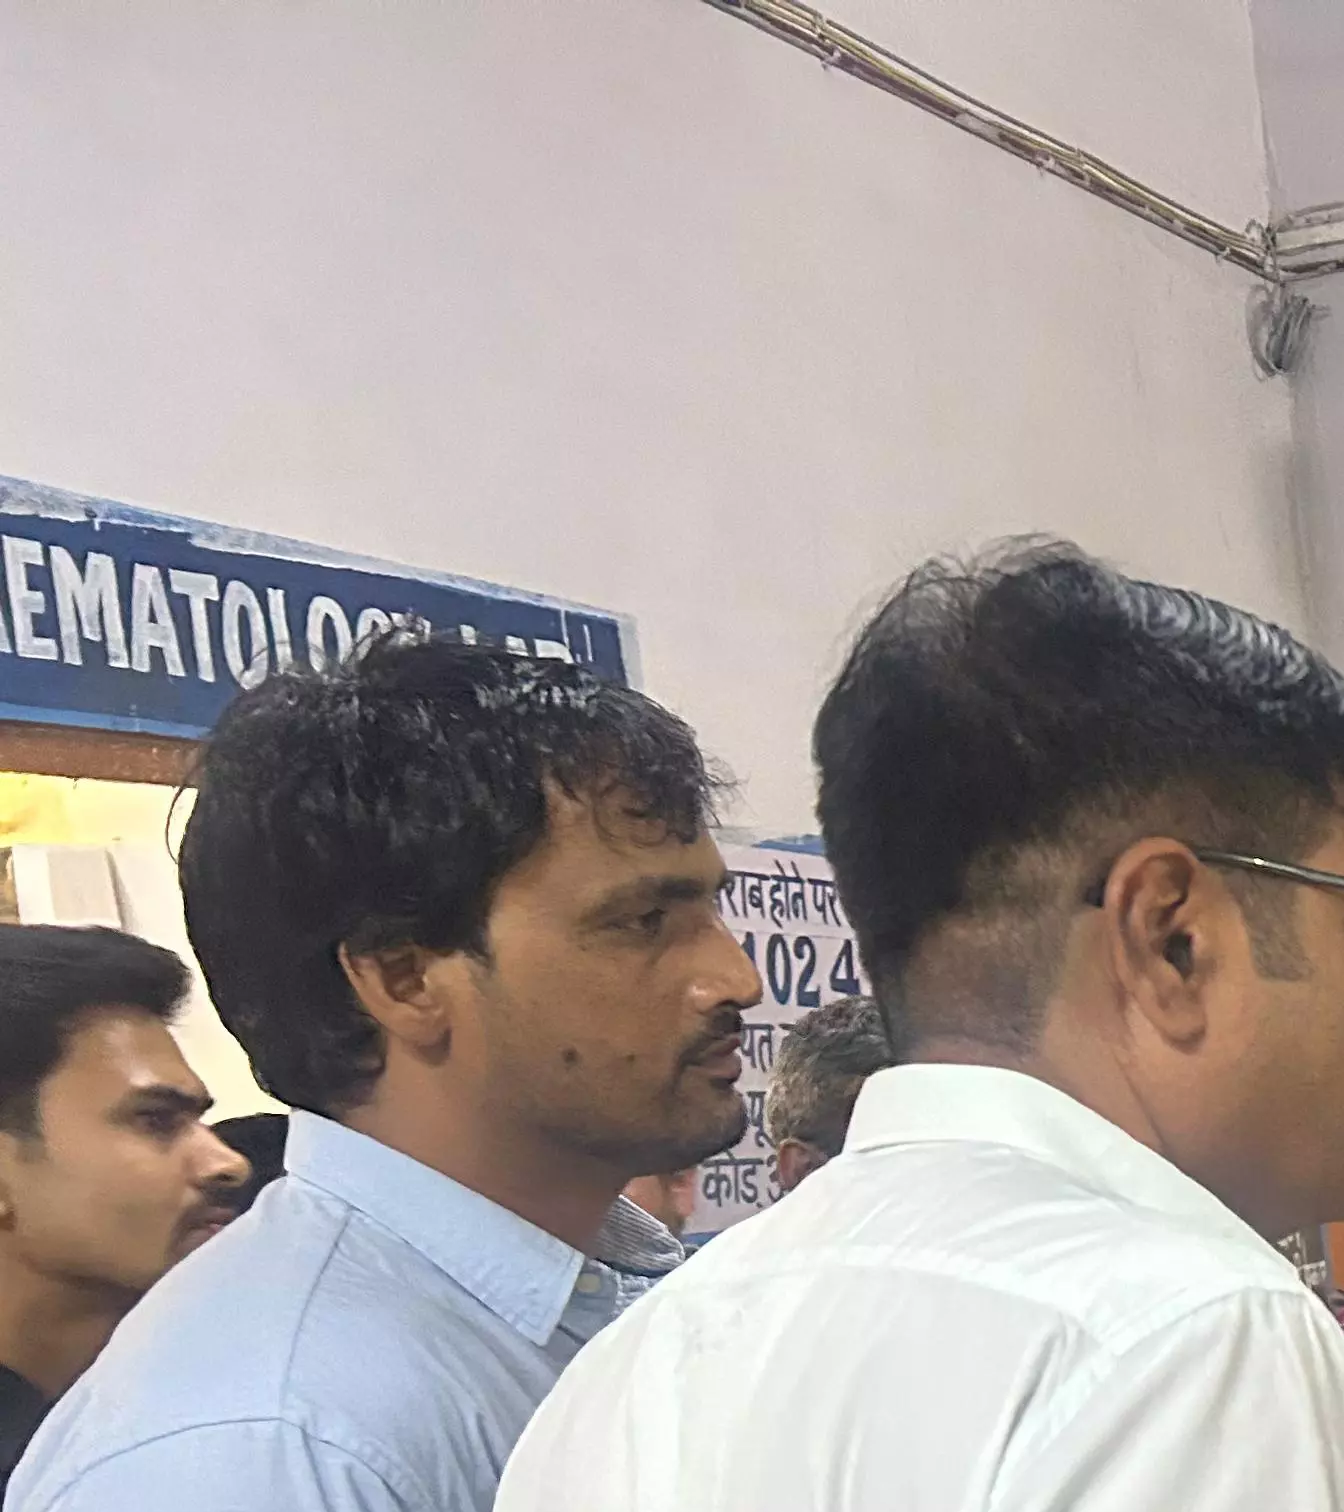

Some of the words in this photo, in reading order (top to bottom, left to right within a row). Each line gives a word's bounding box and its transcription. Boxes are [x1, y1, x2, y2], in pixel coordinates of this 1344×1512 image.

[0, 534, 432, 691] EMATOLO
[719, 870, 765, 920] राब
[807, 878, 842, 928] पर
